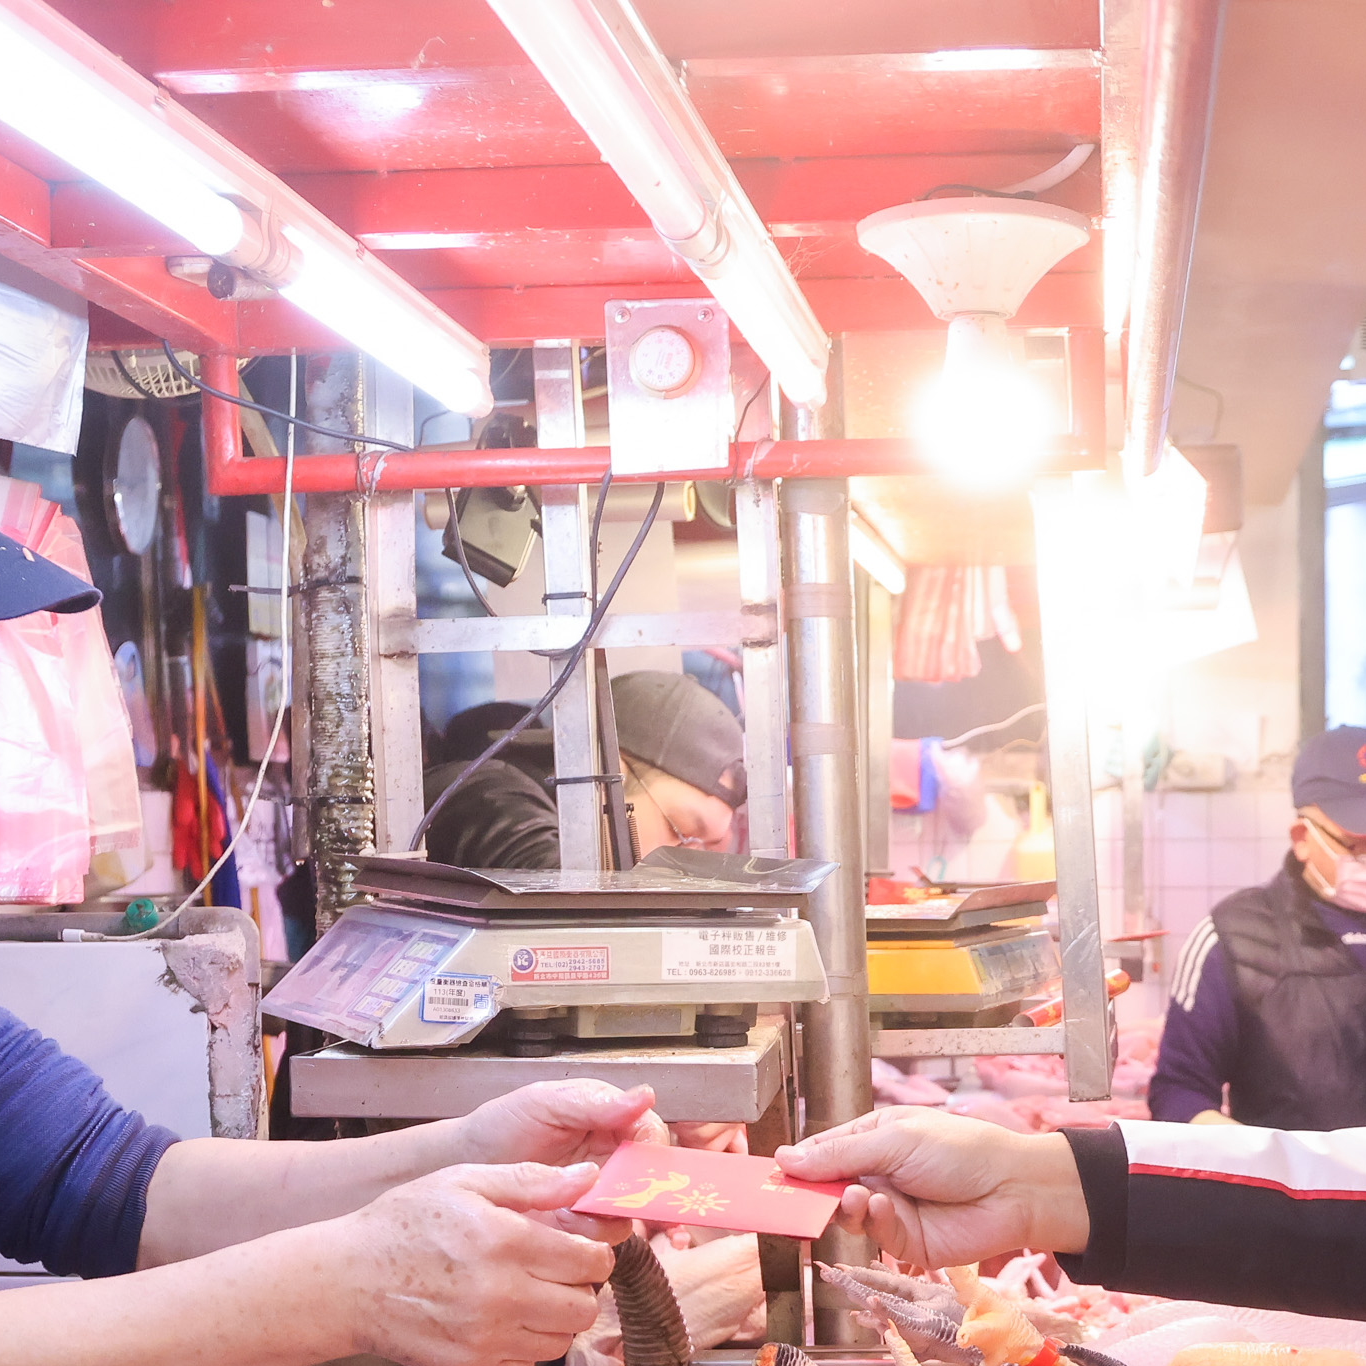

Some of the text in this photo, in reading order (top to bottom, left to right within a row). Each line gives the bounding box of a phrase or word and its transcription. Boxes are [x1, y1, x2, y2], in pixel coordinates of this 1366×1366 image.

[709, 944, 776, 956] 國際校正報告
